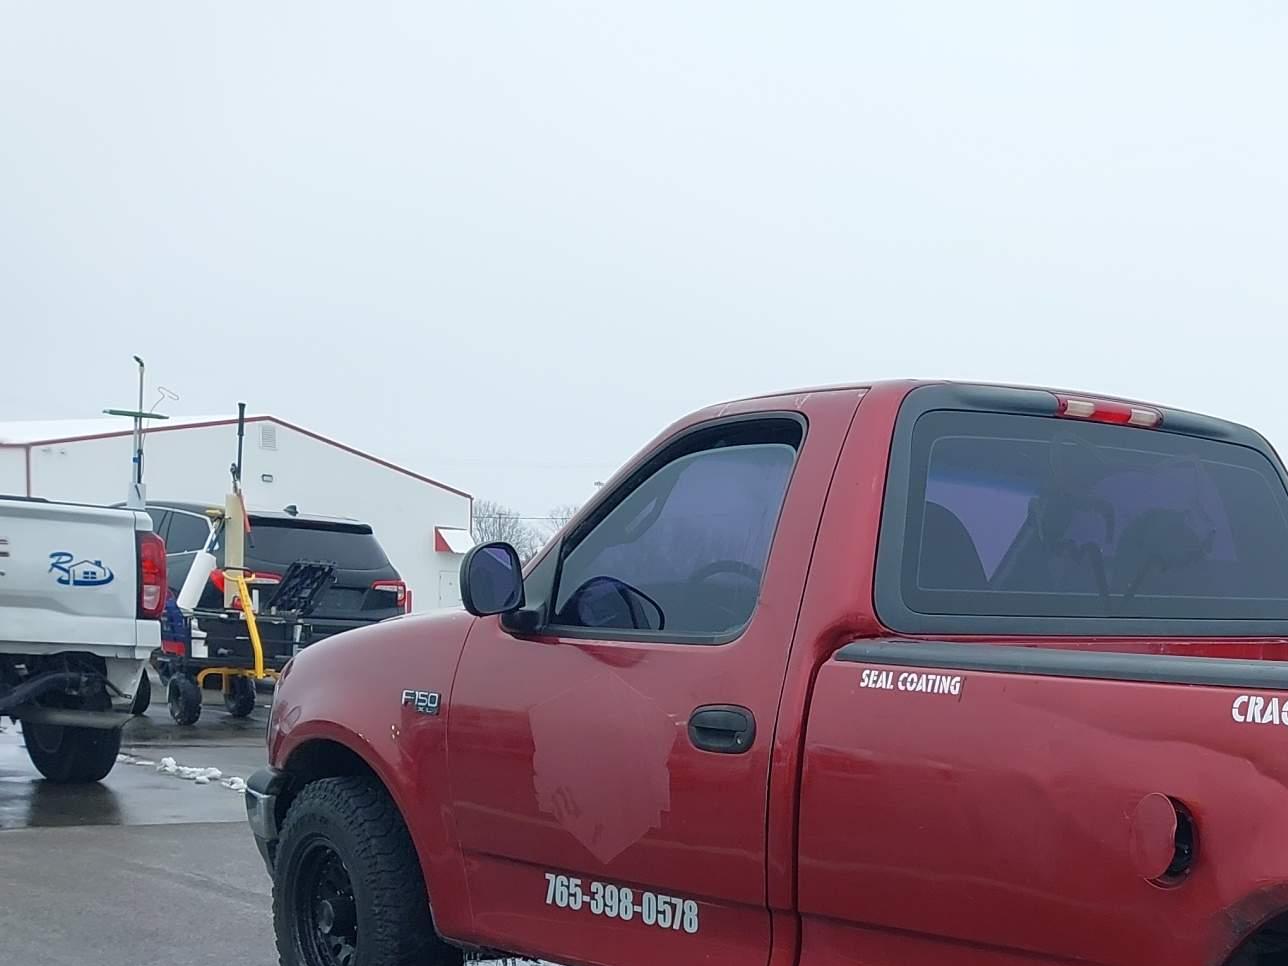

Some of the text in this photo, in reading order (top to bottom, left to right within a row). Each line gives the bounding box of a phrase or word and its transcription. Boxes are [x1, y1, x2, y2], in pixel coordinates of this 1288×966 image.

[860, 669, 961, 695] SEAL COATING
[401, 689, 439, 707] F150
[544, 872, 699, 934] 765-398-0578
